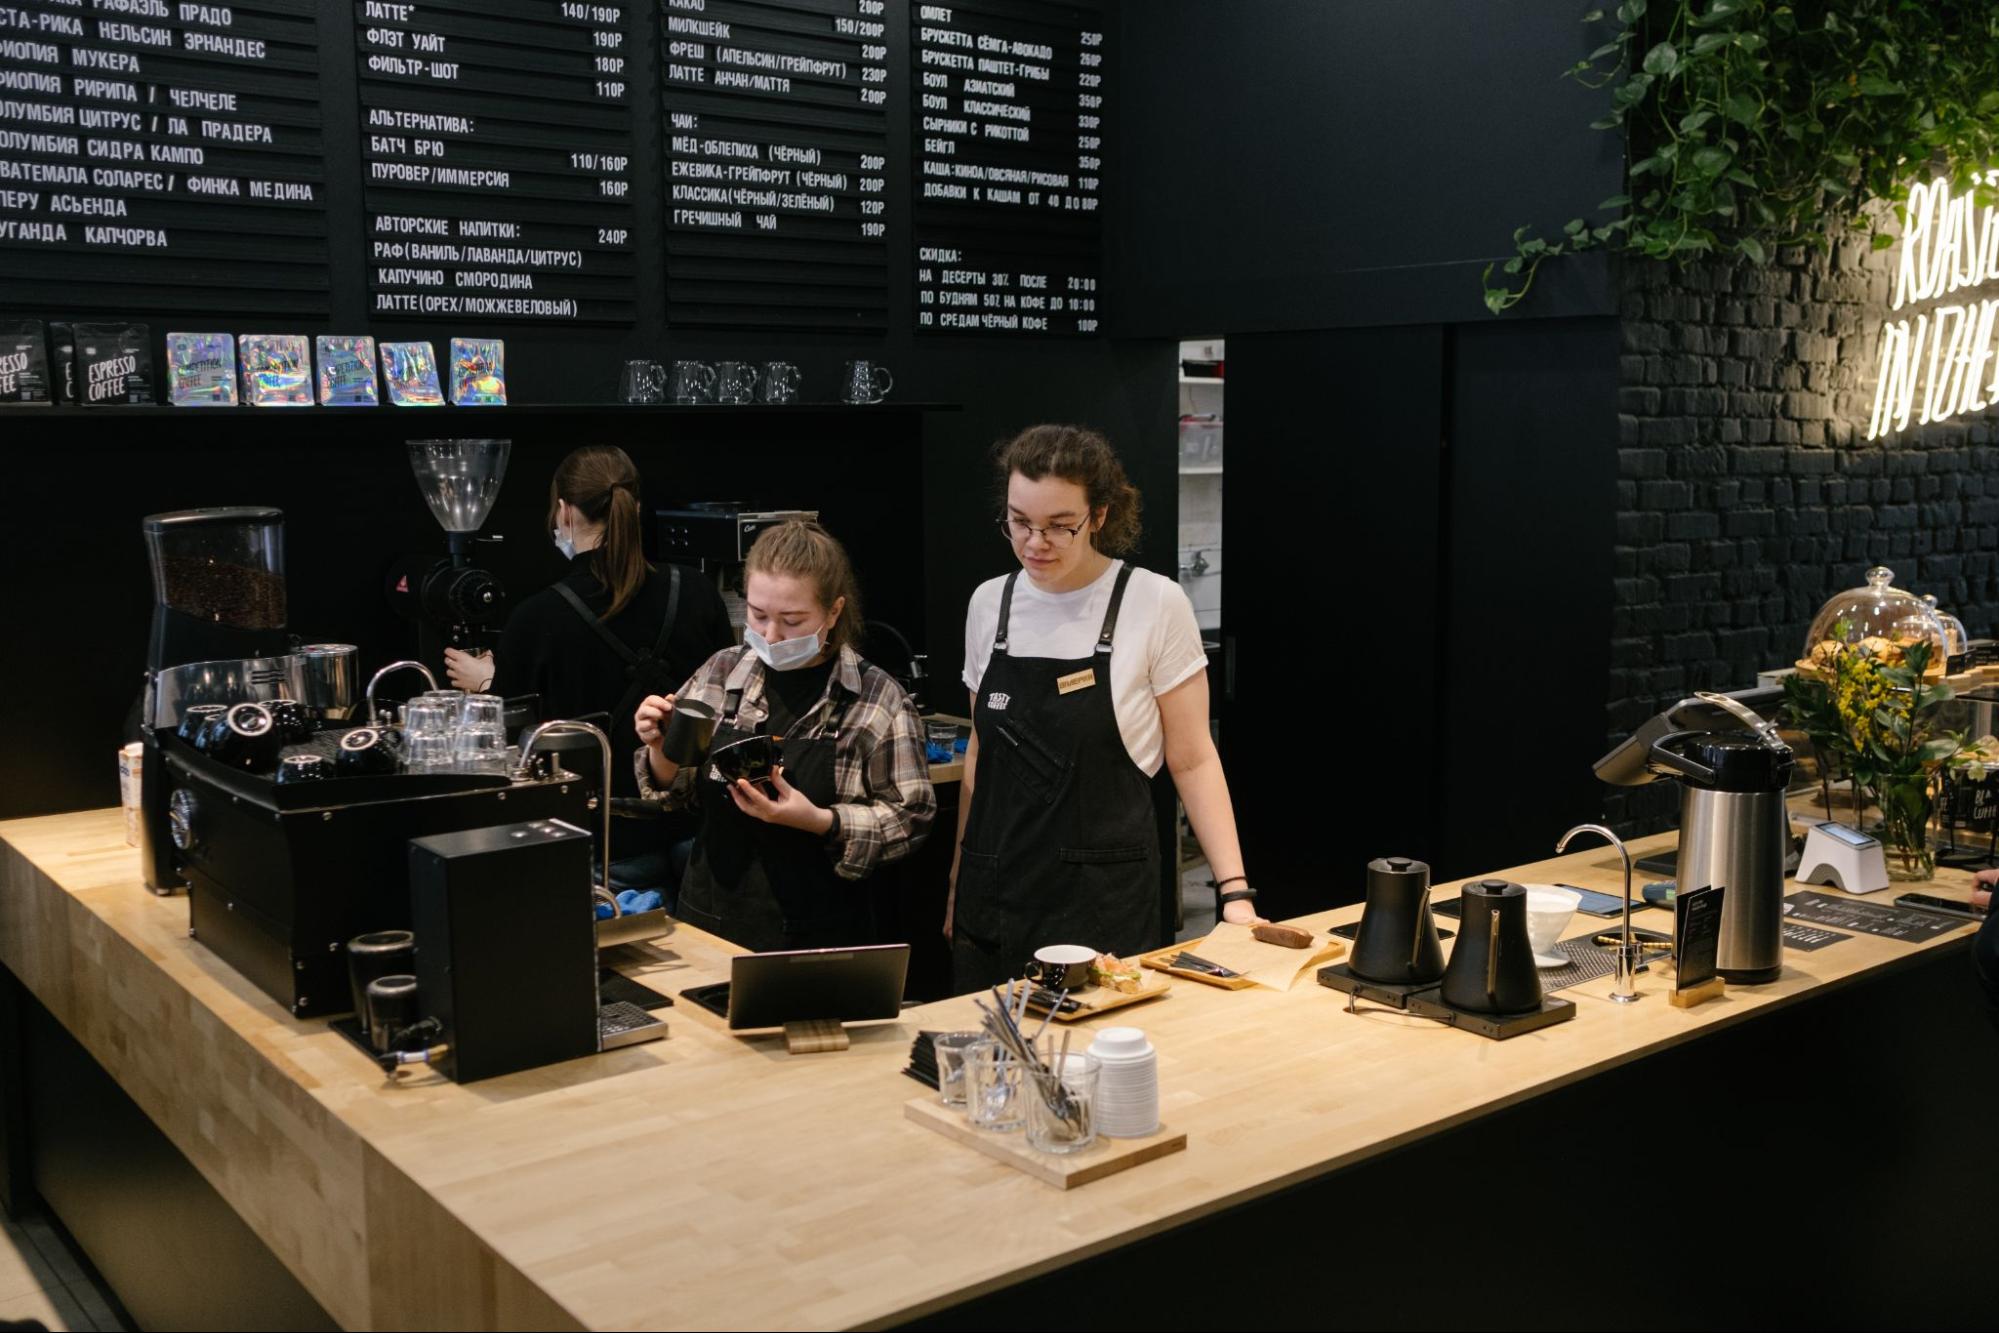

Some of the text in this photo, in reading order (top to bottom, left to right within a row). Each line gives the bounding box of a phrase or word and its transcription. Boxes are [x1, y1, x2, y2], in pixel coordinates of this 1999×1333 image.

[180, 4, 231, 26] ПРАДО
[562, 2, 620, 23] 140/190Р
[859, 0, 884, 15] 200Р
[669, 17, 887, 60] МИЛКШЕЙК 200Р
[836, 18, 884, 37] 150/200Р
[921, 6, 1102, 45] ОМЛЕТ 250Р
[99, 22, 171, 46] НЕЛЬСИН
[184, 33, 265, 58] ЭРНАНДЕС
[367, 28, 623, 73] ФЛЭТ УАЙТ 180Р
[594, 32, 622, 48] 190Р
[921, 27, 973, 48] БРУСКЕТТА
[1080, 53, 1101, 66] 260Р
[0, 40, 139, 72] ИОПИЯ МУКЕРА
[670, 42, 704, 59] ФРЕШ
[862, 68, 887, 82] 230Р
[922, 49, 974, 70] БРУСКЕТТА
[1079, 73, 1101, 87] 220Р
[369, 56, 624, 97] ФИЛЬТР-ШОТ 110Р
[669, 64, 704, 82] ЛАТТЕ
[861, 88, 886, 104] 200Р
[923, 72, 1102, 108] БОУЛ АЗИАТСКИЙ 350Р
[74, 79, 137, 101] РИРИПА
[170, 89, 236, 110] ЧЕЛЧЕЛЕ
[370, 110, 473, 133] АЛЬТЕРНАТИВА:
[923, 94, 1100, 128] БОУЛ КЛАССИЧЕСКИЙ 330Р
[79, 109, 141, 131] ЦИТРУС
[168, 118, 188, 135] ЛА
[202, 121, 272, 143] ПРАДЕРА
[923, 116, 1100, 149] СЫРНИКИ С РИКОТТОЙ 250Р
[0, 130, 203, 164] ОЛУМБИЯ СИДРА КАМПО
[372, 136, 627, 171] БАТЧ БРЮ 110/160Р
[925, 139, 1100, 170] БЕЙГЛ 350Р
[861, 155, 885, 170] 200Р
[0, 161, 88, 184] ВАТЕМАЛА
[188, 177, 239, 195] ФИНКА
[250, 181, 312, 200] МЕДИНА
[372, 163, 628, 196] ПУРОВЕР/ИММЕРСИЯ 160Р
[860, 178, 884, 192] 200Р
[1079, 177, 1099, 190] 110Р
[0, 190, 127, 217] ПЕРУ АСЬЕНДА
[861, 201, 884, 214] 120Р
[924, 183, 966, 198] ДОБАВКИ
[974, 188, 979, 200] К
[987, 188, 1020, 203] КАШАМ
[1029, 192, 1040, 205] ОТ
[1048, 195, 1059, 207] 40
[0, 221, 167, 246] УГАНДА КАПЧОРВА
[376, 216, 627, 244] АВТОРСКИЕ НАПИТКИ: 240Р
[674, 210, 885, 236] ГРЕЧИШНЫЙ ЧАЙ 190Р
[920, 248, 961, 263] СКИДКА:
[379, 269, 532, 289] КАПУЧИНО СМОРОДИНА
[920, 269, 932, 281] НА
[942, 270, 985, 284] ДЕСЕРТЫ
[1020, 274, 1046, 288] ПОСЛЕ
[1068, 277, 1095, 291] 20:00
[921, 291, 933, 303] ПО
[940, 291, 977, 305] БУДНЯМ
[1004, 295, 1016, 307] НА
[1021, 296, 1045, 309] КОФЕ
[1069, 298, 1094, 311] 10:00
[920, 312, 1098, 331] ПО СРЕДАМ ЧЁРНЫЙ КОФЕ 100Р
[88, 355, 136, 383] ESPRESSO
[88, 376, 125, 401] COFFEE
